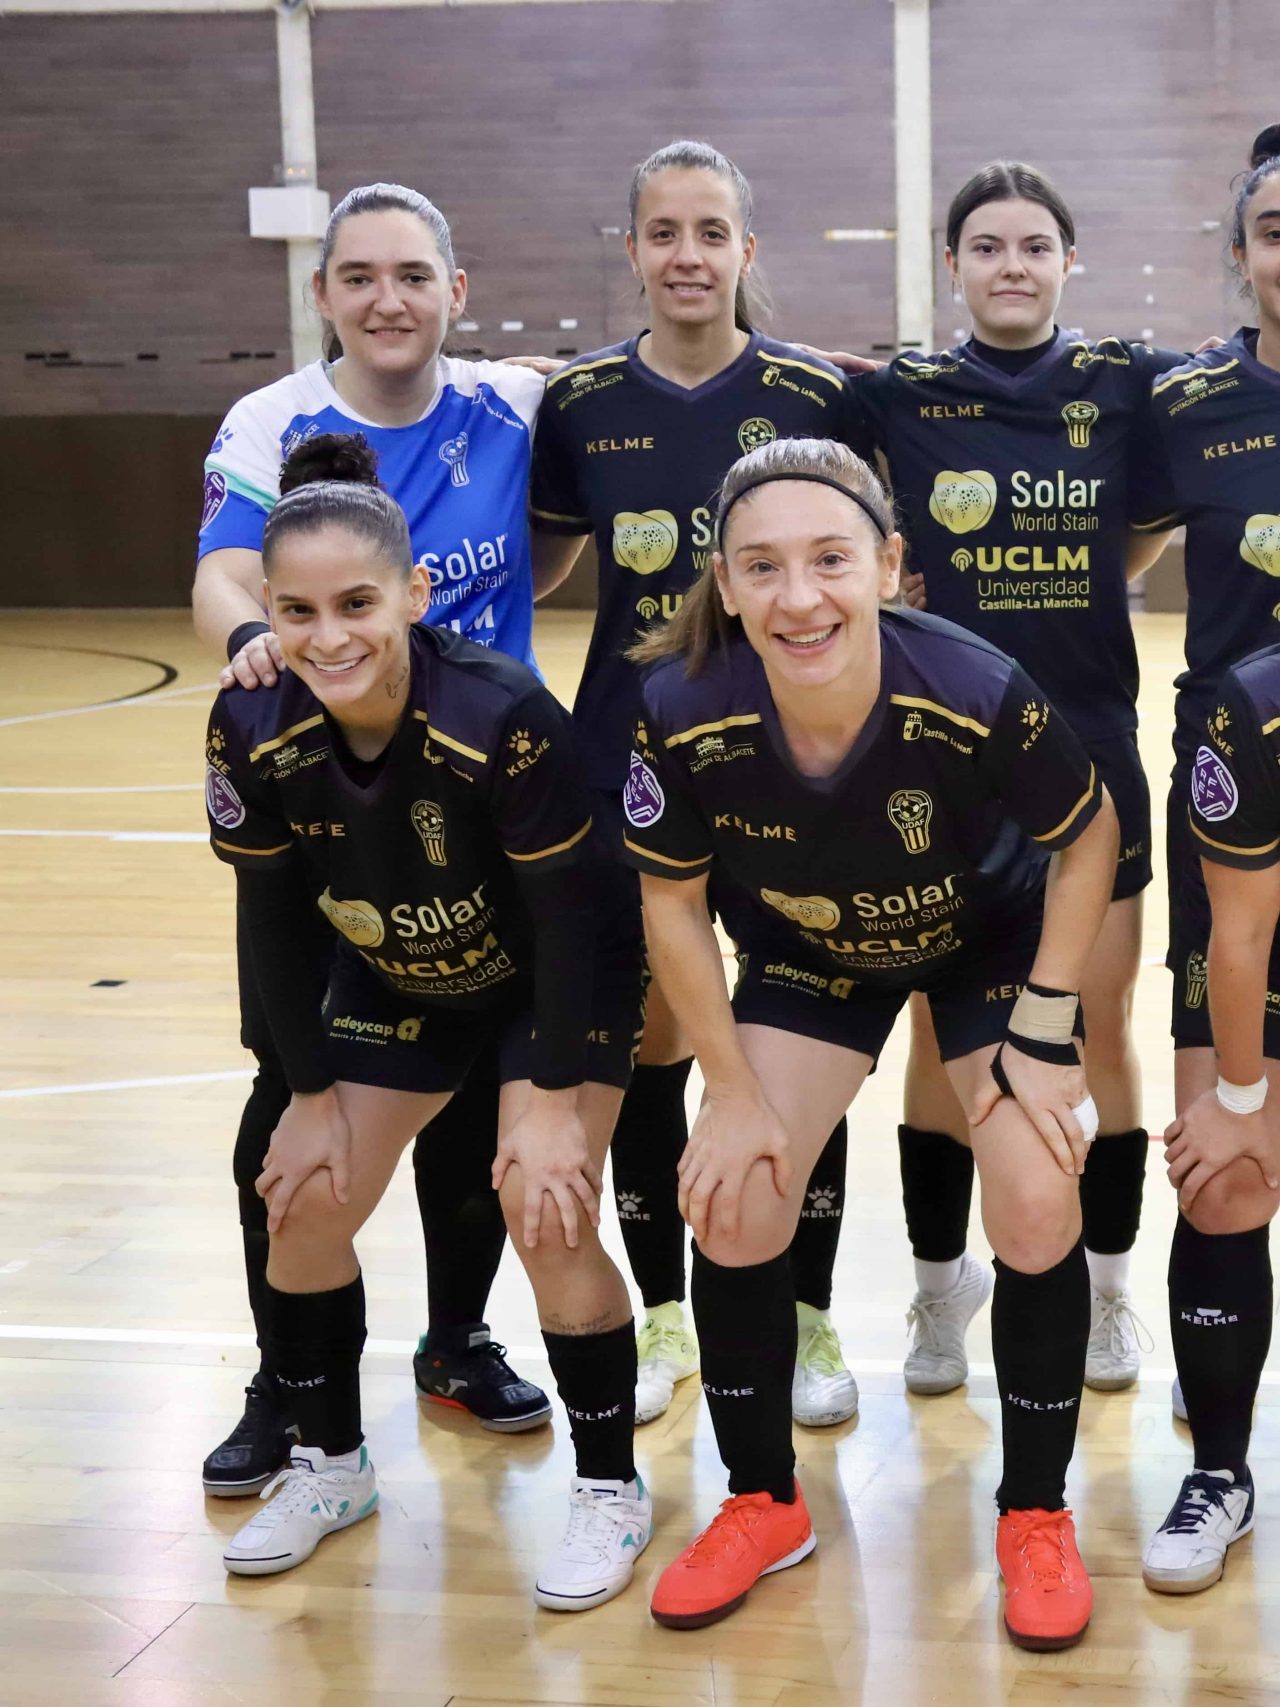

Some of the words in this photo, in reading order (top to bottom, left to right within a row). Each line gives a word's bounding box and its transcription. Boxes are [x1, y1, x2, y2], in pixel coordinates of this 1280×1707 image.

[1208, 380, 1240, 395] ALBACETE
[920, 404, 985, 418] KELME
[586, 437, 654, 454] KELME
[1203, 435, 1277, 460] KELME
[1011, 470, 1101, 509] Solar
[1011, 513, 1057, 531] World
[1062, 512, 1099, 532] Stain
[424, 533, 505, 587] Solar
[977, 545, 1089, 572] UCLM
[430, 582, 472, 607] World
[476, 570, 508, 593] Stain
[977, 577, 1090, 597] Universidad
[979, 599, 1041, 611] Castilla-La
[1043, 597, 1089, 609] Mancha
[1022, 702, 1051, 752] KELME
[1207, 716, 1234, 758] KELME
[923, 727, 948, 742] Castilla
[957, 745, 973, 755] Man
[506, 737, 551, 777] KELME
[724, 747, 756, 763] ALBACETE
[901, 818, 925, 829] UDAF
[423, 831, 442, 840] UDAF
[852, 873, 958, 918] Solar
[390, 885, 484, 938] Solar
[861, 915, 916, 933] World
[921, 896, 966, 923] Stain
[402, 935, 455, 955] World
[457, 907, 496, 942] Stain
[824, 922, 953, 953] UCLM
[376, 932, 498, 977] UCLM
[388, 949, 512, 990] Universidad
[764, 962, 828, 989] adeycap
[986, 984, 1027, 1003] KEL
[332, 1016, 394, 1037] adeycap
[618, 1213, 650, 1221] ELME
[801, 1209, 841, 1221] KELME
[1180, 1312, 1239, 1326] KELME
[275, 1375, 327, 1389] ELME
[702, 1385, 755, 1397] ELME
[1008, 1392, 1078, 1412] KELME
[565, 1404, 622, 1422] KELME
